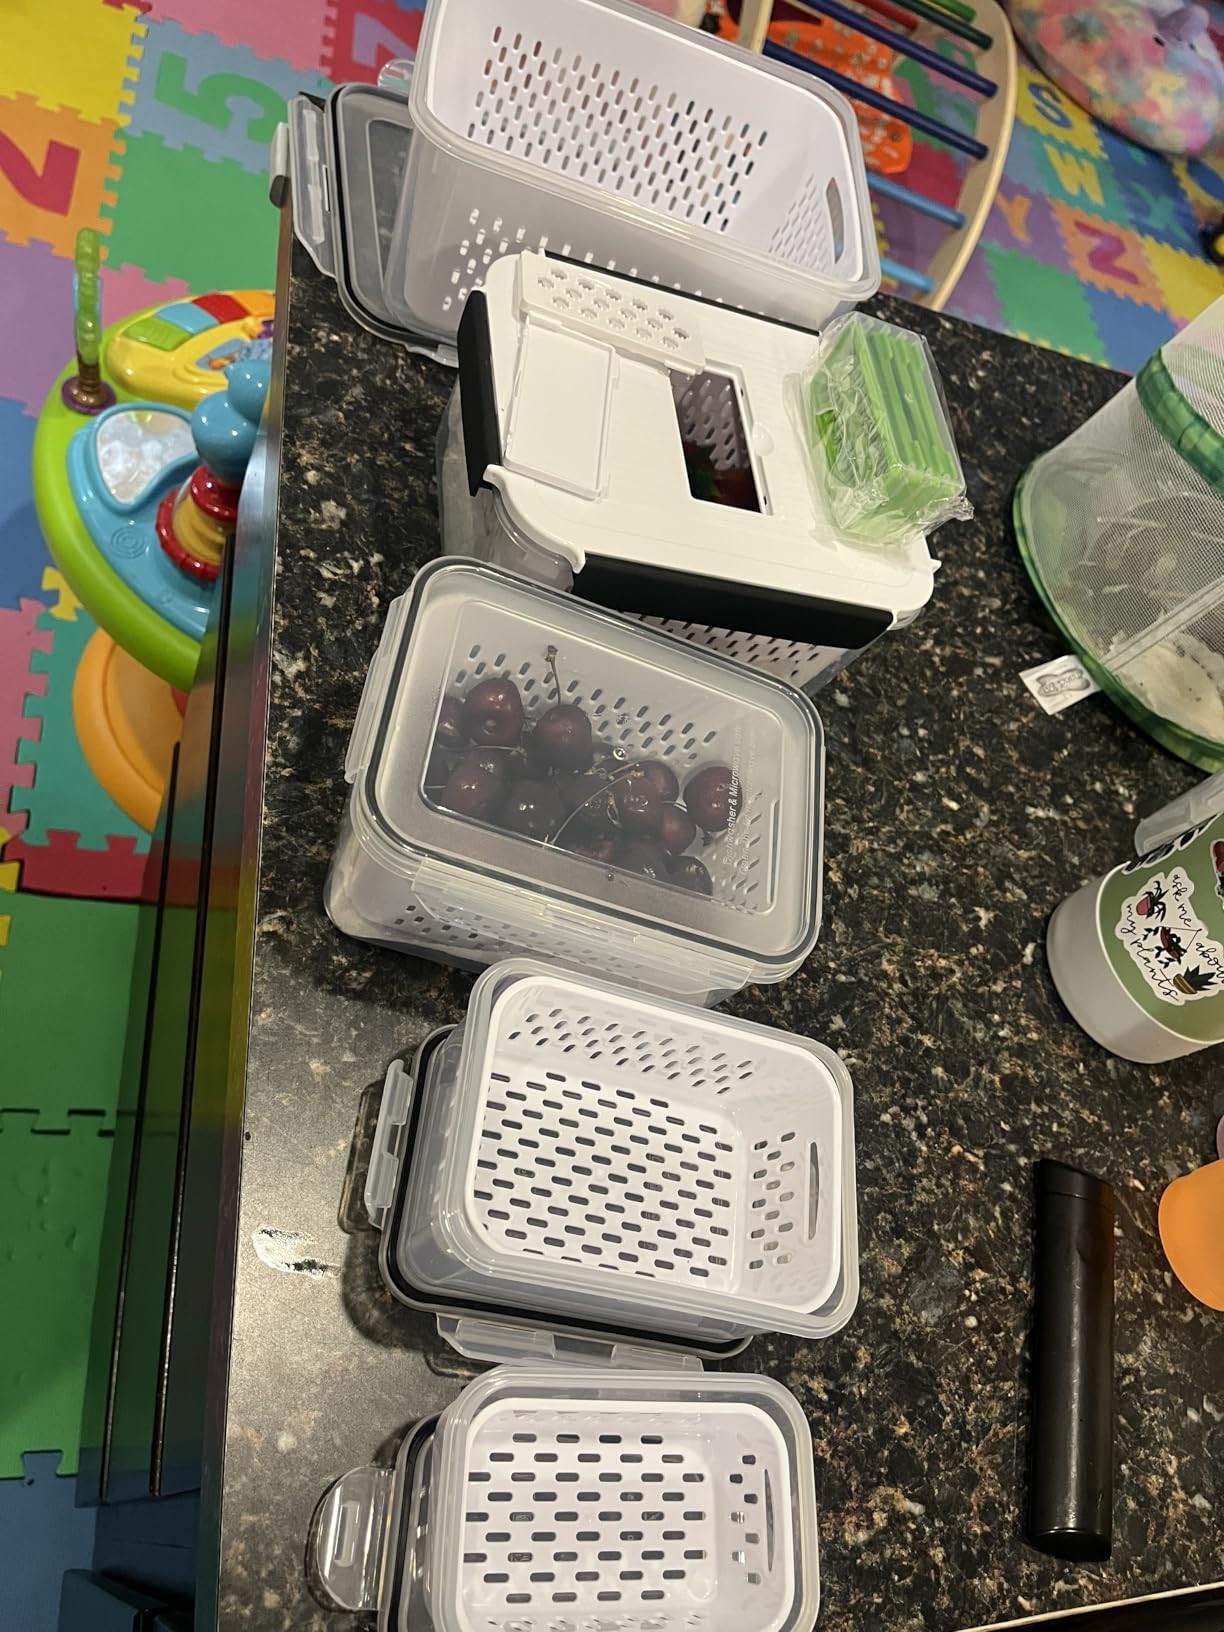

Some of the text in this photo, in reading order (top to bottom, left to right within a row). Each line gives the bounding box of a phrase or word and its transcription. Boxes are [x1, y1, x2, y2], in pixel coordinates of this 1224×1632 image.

[155, 51, 287, 143] 5
[1029, 82, 1072, 129] S
[724, 806, 737, 864] Dishwasher
[1120, 903, 1180, 1001] my plants
[1171, 873, 1224, 984] ask me abou
